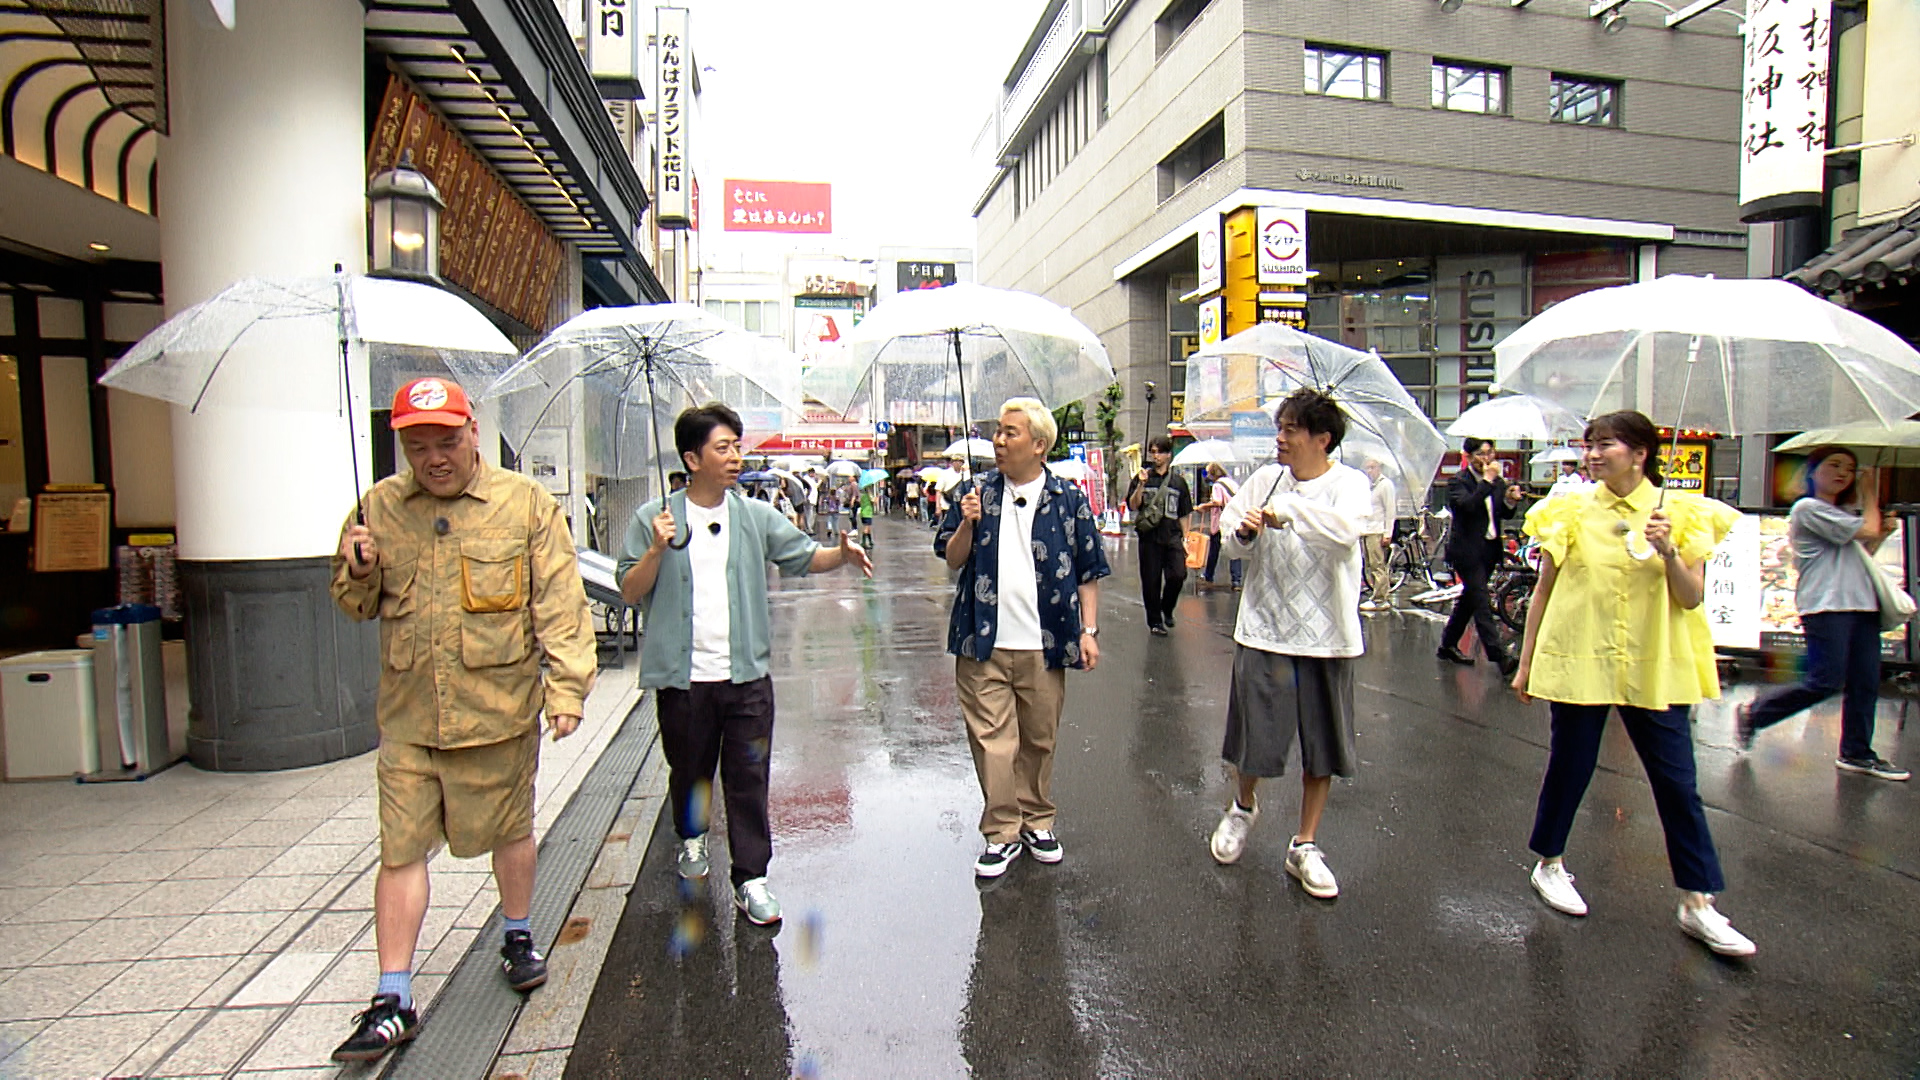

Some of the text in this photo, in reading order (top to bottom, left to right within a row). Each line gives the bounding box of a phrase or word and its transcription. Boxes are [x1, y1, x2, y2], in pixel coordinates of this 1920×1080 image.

[601, 0, 625, 37] 月
[663, 34, 681, 191] なんばグランド花月
[733, 187, 768, 204] そこに
[908, 264, 945, 278] 千日前
[1261, 264, 1304, 274] SUSHIRO
[1466, 269, 1495, 412] SUSHIR
[1712, 530, 1736, 624] 席個室
